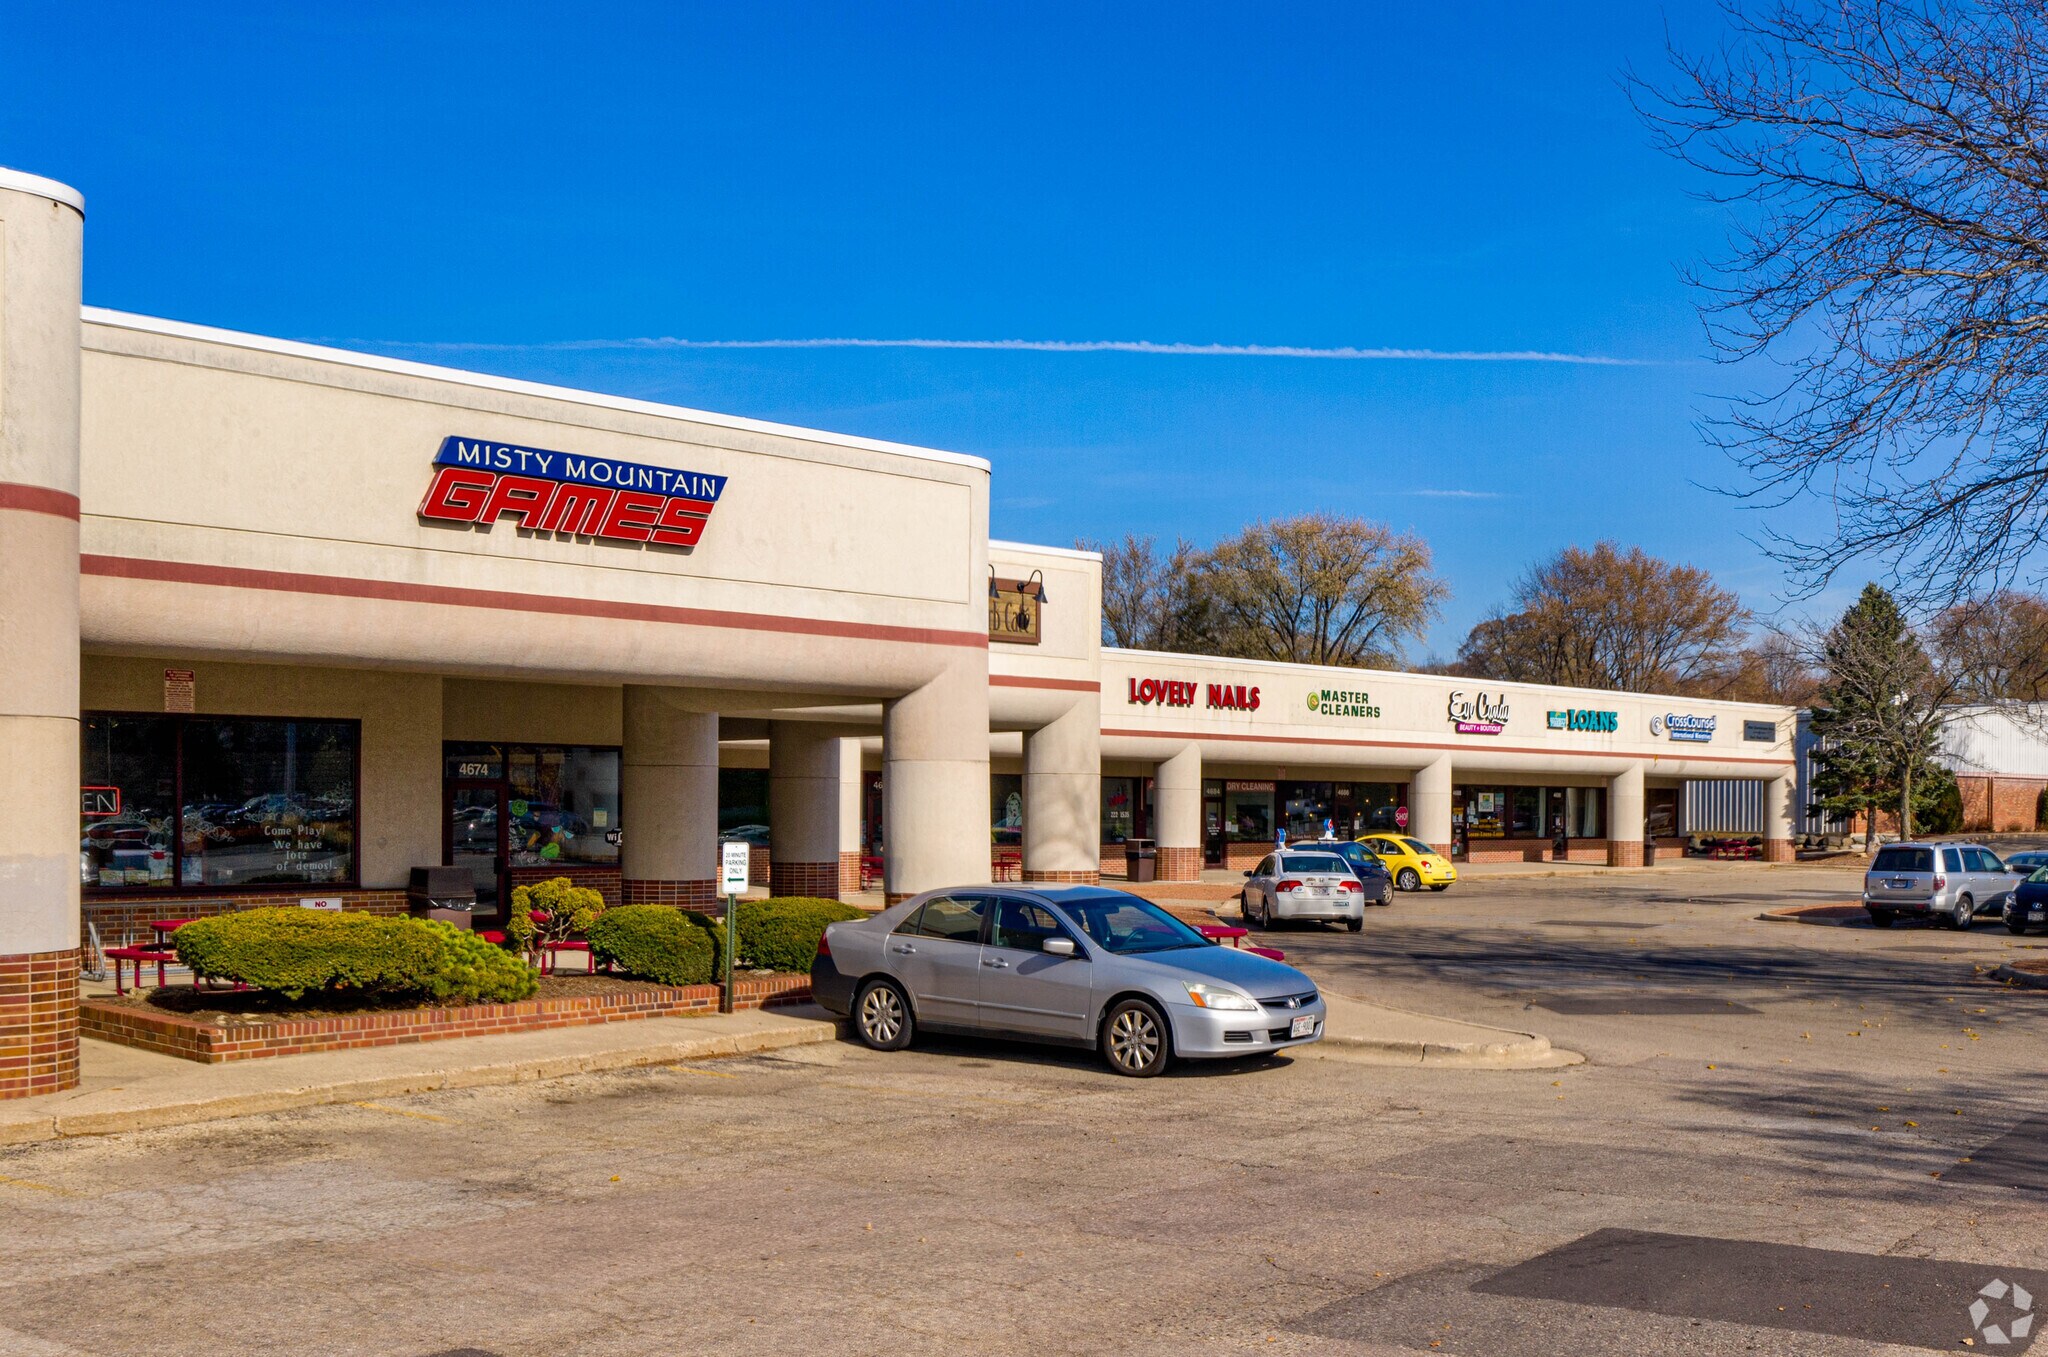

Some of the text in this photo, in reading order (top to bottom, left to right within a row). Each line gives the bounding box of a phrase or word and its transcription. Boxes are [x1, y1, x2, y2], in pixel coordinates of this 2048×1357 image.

[457, 441, 717, 498] MISTY MOUNTAIN
[421, 468, 715, 546] GAMES
[1129, 678, 1260, 710] LOVELY NAILS
[1321, 690, 1369, 704] MASTER
[1321, 703, 1381, 718] CLEANERS
[1569, 709, 1618, 731] LOANS
[1666, 713, 1716, 731] CrossCounsel
[459, 763, 489, 776] 4674
[1226, 782, 1274, 791] DRY CLEANING
[82, 792, 117, 813] EN
[264, 824, 326, 837] Come Play!
[273, 840, 322, 849] We have
[286, 850, 308, 860] lots
[276, 861, 289, 871] of
[725, 859, 747, 867] PARKING
